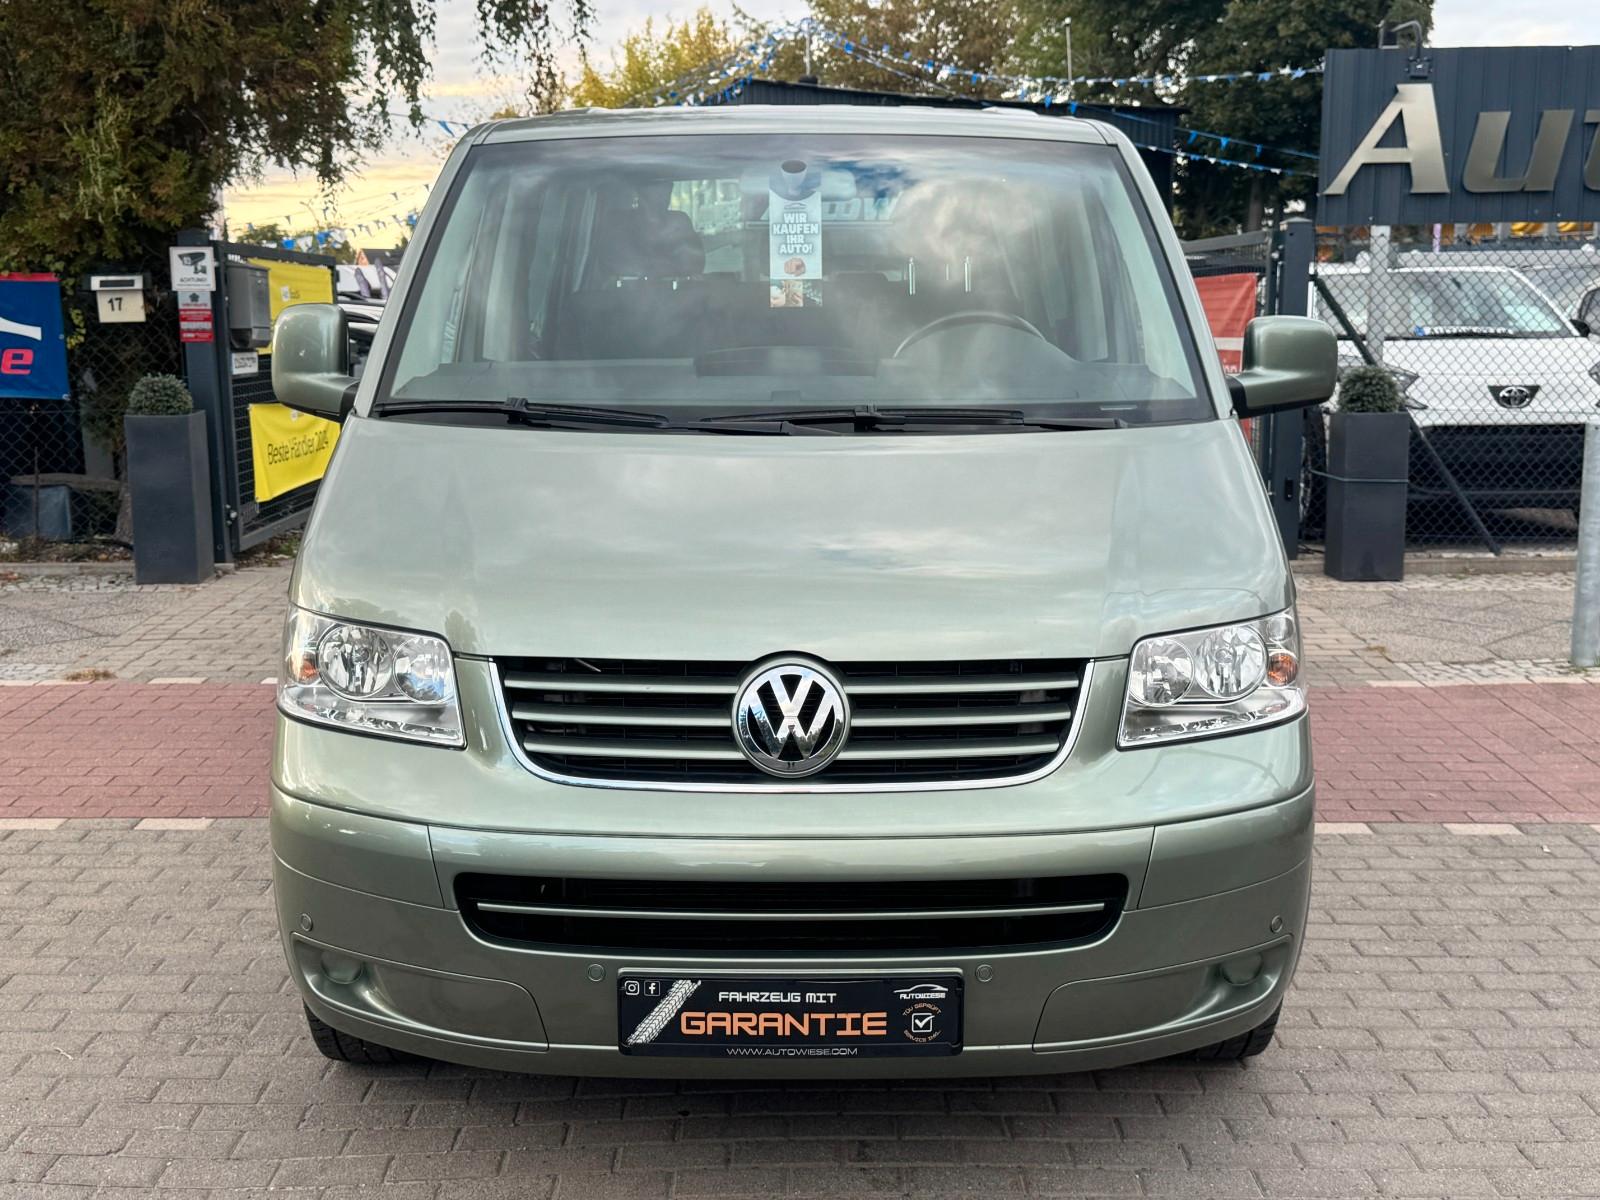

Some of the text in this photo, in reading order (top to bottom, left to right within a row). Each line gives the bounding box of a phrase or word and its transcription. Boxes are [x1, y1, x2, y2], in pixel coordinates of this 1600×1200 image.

[1323, 83, 1600, 195] Au
[783, 213, 807, 224] WIR
[773, 224, 819, 235] KAUFEN
[786, 234, 805, 244] IHR
[779, 244, 813, 254] AUTO!
[107, 297, 123, 312] 17
[267, 442, 289, 465] Beste
[719, 992, 838, 1003] FAHRZEUG MIT
[681, 1012, 888, 1036] GARANTIE
[726, 1048, 858, 1056] WWW.AUTOWIESE.COM
